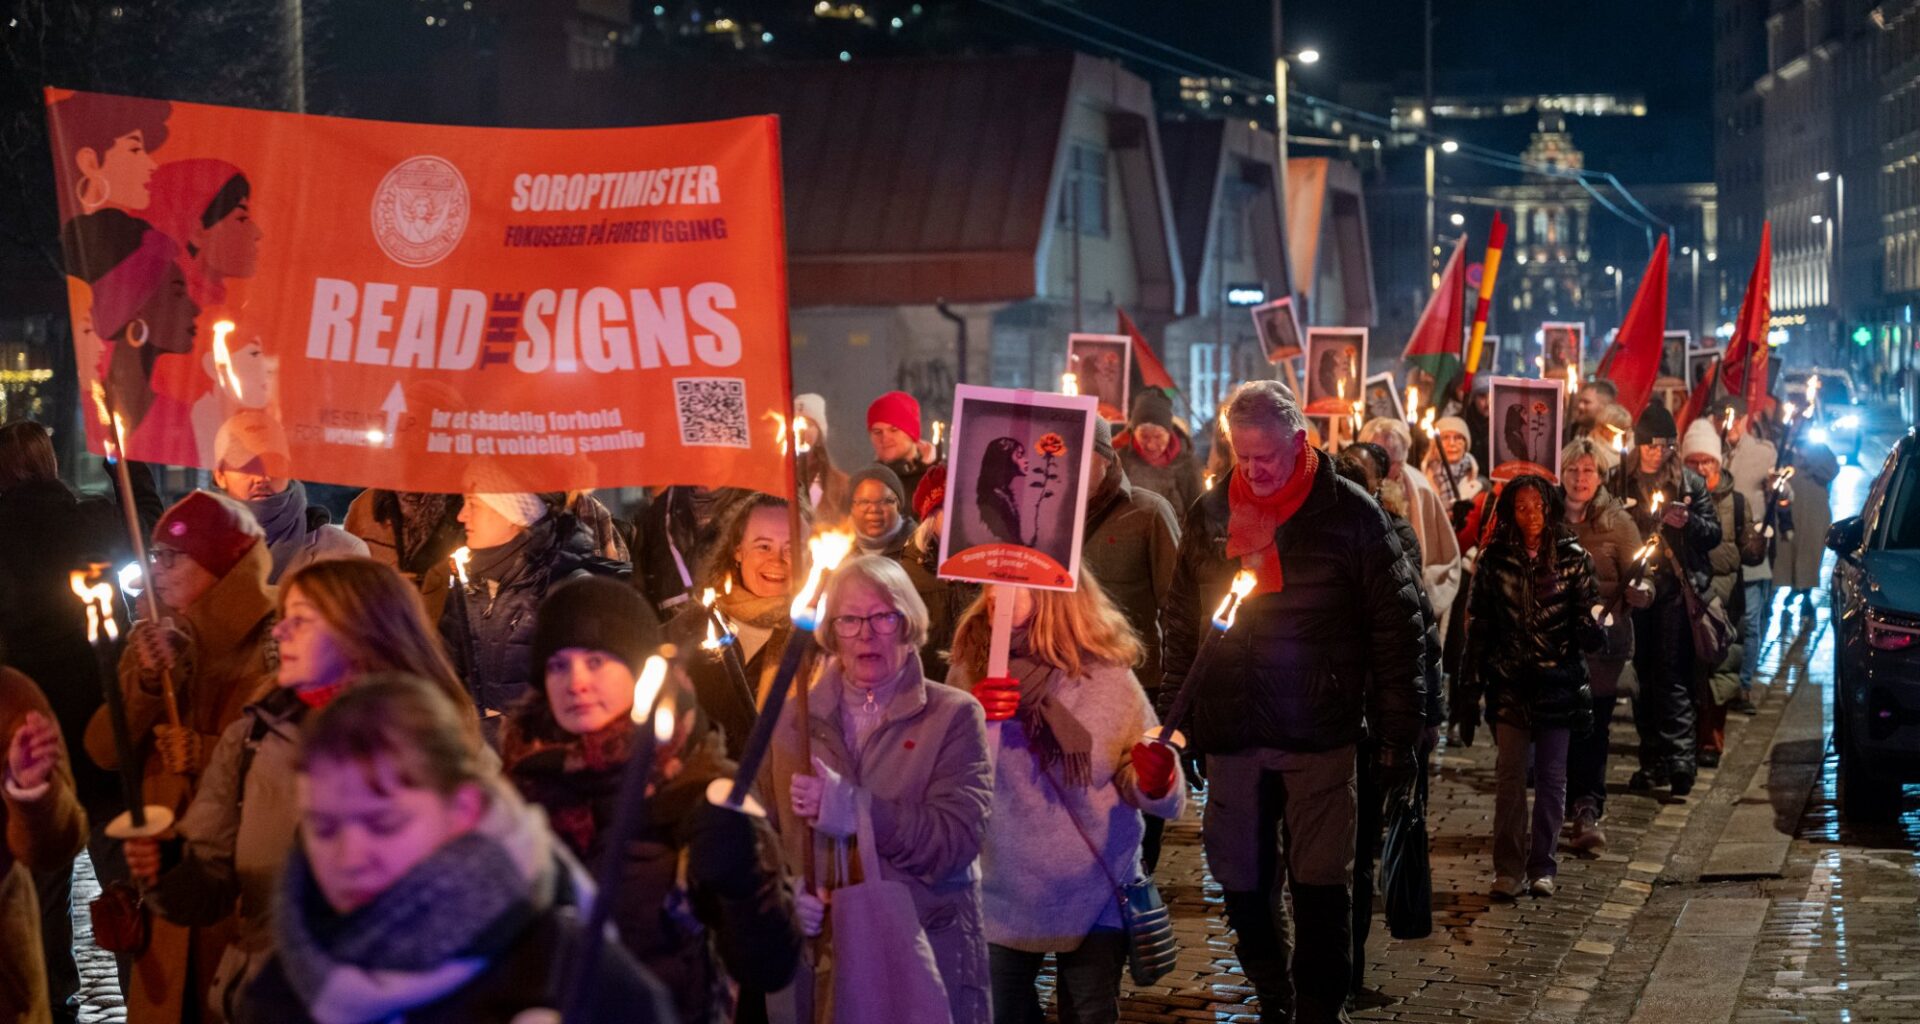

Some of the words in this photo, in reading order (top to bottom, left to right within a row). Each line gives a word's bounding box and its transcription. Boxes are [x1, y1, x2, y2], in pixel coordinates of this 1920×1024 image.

[511, 165, 721, 212] SOROPTIMISTER
[504, 223, 587, 248] FOKUSERER
[587, 218, 606, 246] PÅ
[607, 217, 729, 245] FOREBYGGING
[305, 277, 488, 370] READ
[480, 291, 526, 371] THE
[513, 281, 743, 373] SIGNS
[469, 410, 546, 433] skadelig
[548, 408, 622, 431] forhold
[496, 435, 576, 455] voldelig
[578, 430, 645, 452] samliv
